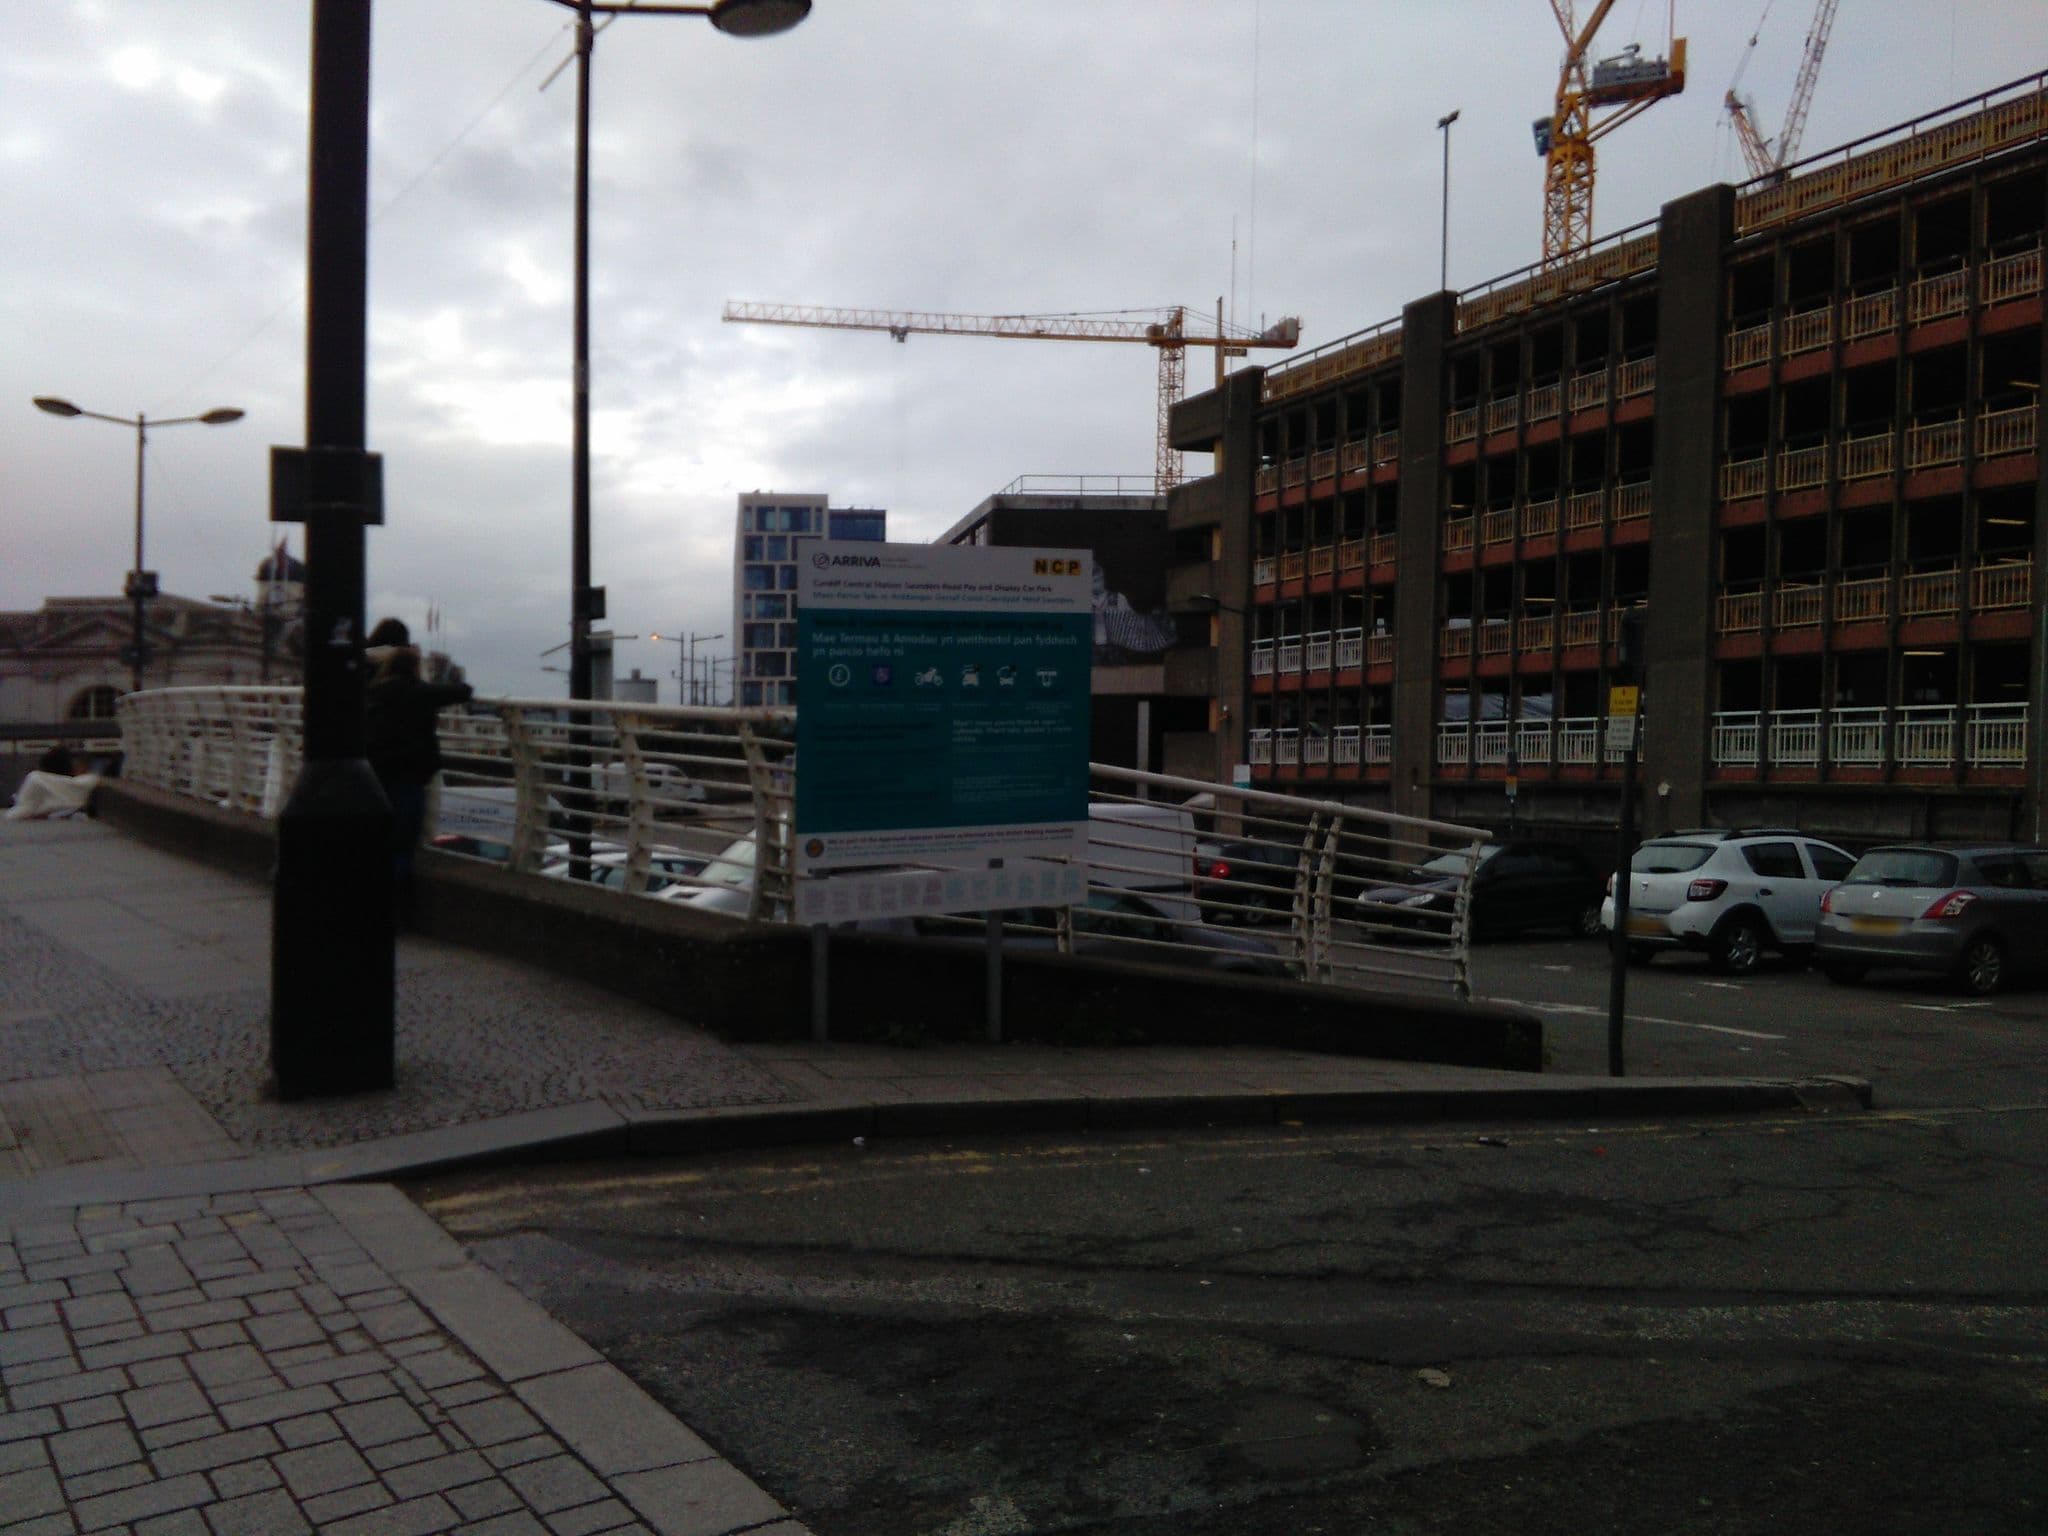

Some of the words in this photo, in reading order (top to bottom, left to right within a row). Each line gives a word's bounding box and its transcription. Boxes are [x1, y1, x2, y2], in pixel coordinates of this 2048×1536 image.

[832, 555, 881, 567] ARRIVA
[1034, 559, 1080, 575] NCP
[812, 631, 837, 644] Mae
